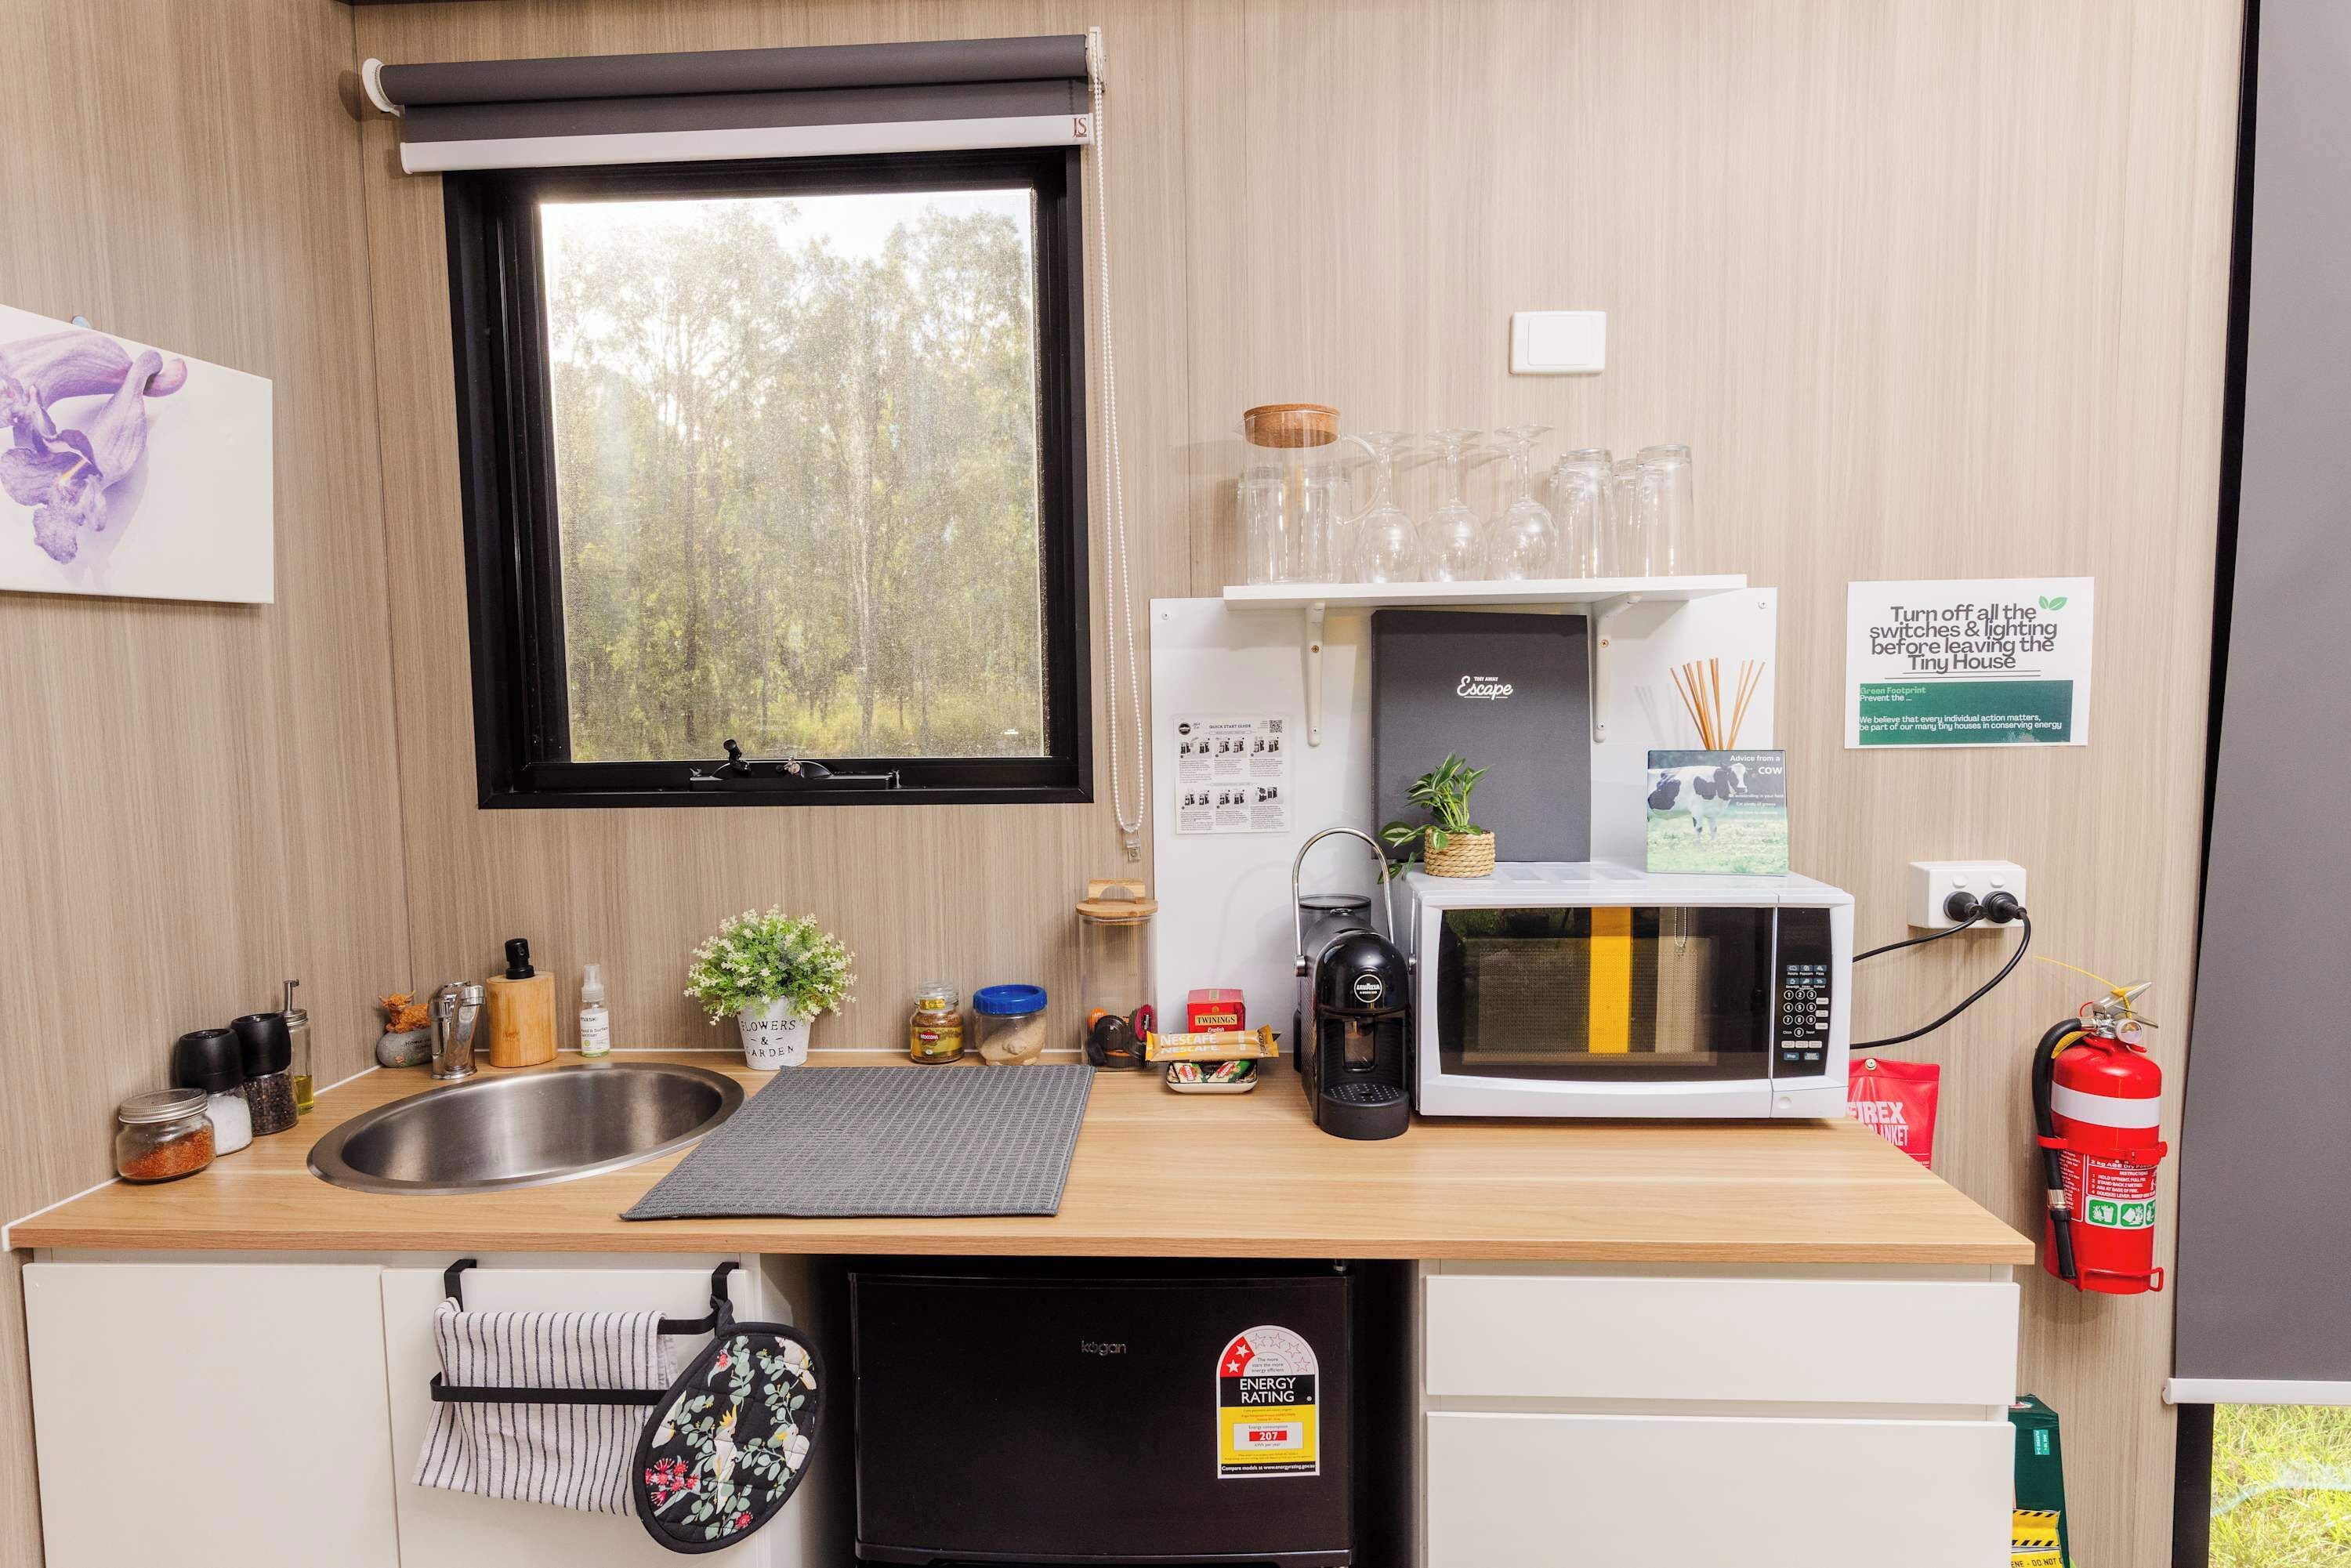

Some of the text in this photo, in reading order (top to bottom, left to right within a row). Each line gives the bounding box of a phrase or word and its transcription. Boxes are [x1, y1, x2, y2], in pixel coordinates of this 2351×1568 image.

[1890, 603, 2037, 622] Turn off all the
[1870, 618, 2057, 640] switches & lighting
[1872, 636, 2055, 657] before leaving the
[1907, 654, 2016, 674] Tiny House
[1457, 675, 1513, 701] Escape
[1887, 686, 1926, 696] Footprint
[1920, 716, 1943, 725] every
[1937, 722, 1953, 731] tiny
[1991, 721, 2033, 730] conserving
[741, 1019, 796, 1032] FLOWERS
[761, 1036, 769, 1045] &
[1081, 1340, 1127, 1356] kogan
[1240, 1377, 1296, 1391] ENERGY
[1241, 1390, 1295, 1403] RATING
[1259, 1431, 1278, 1441] 207
